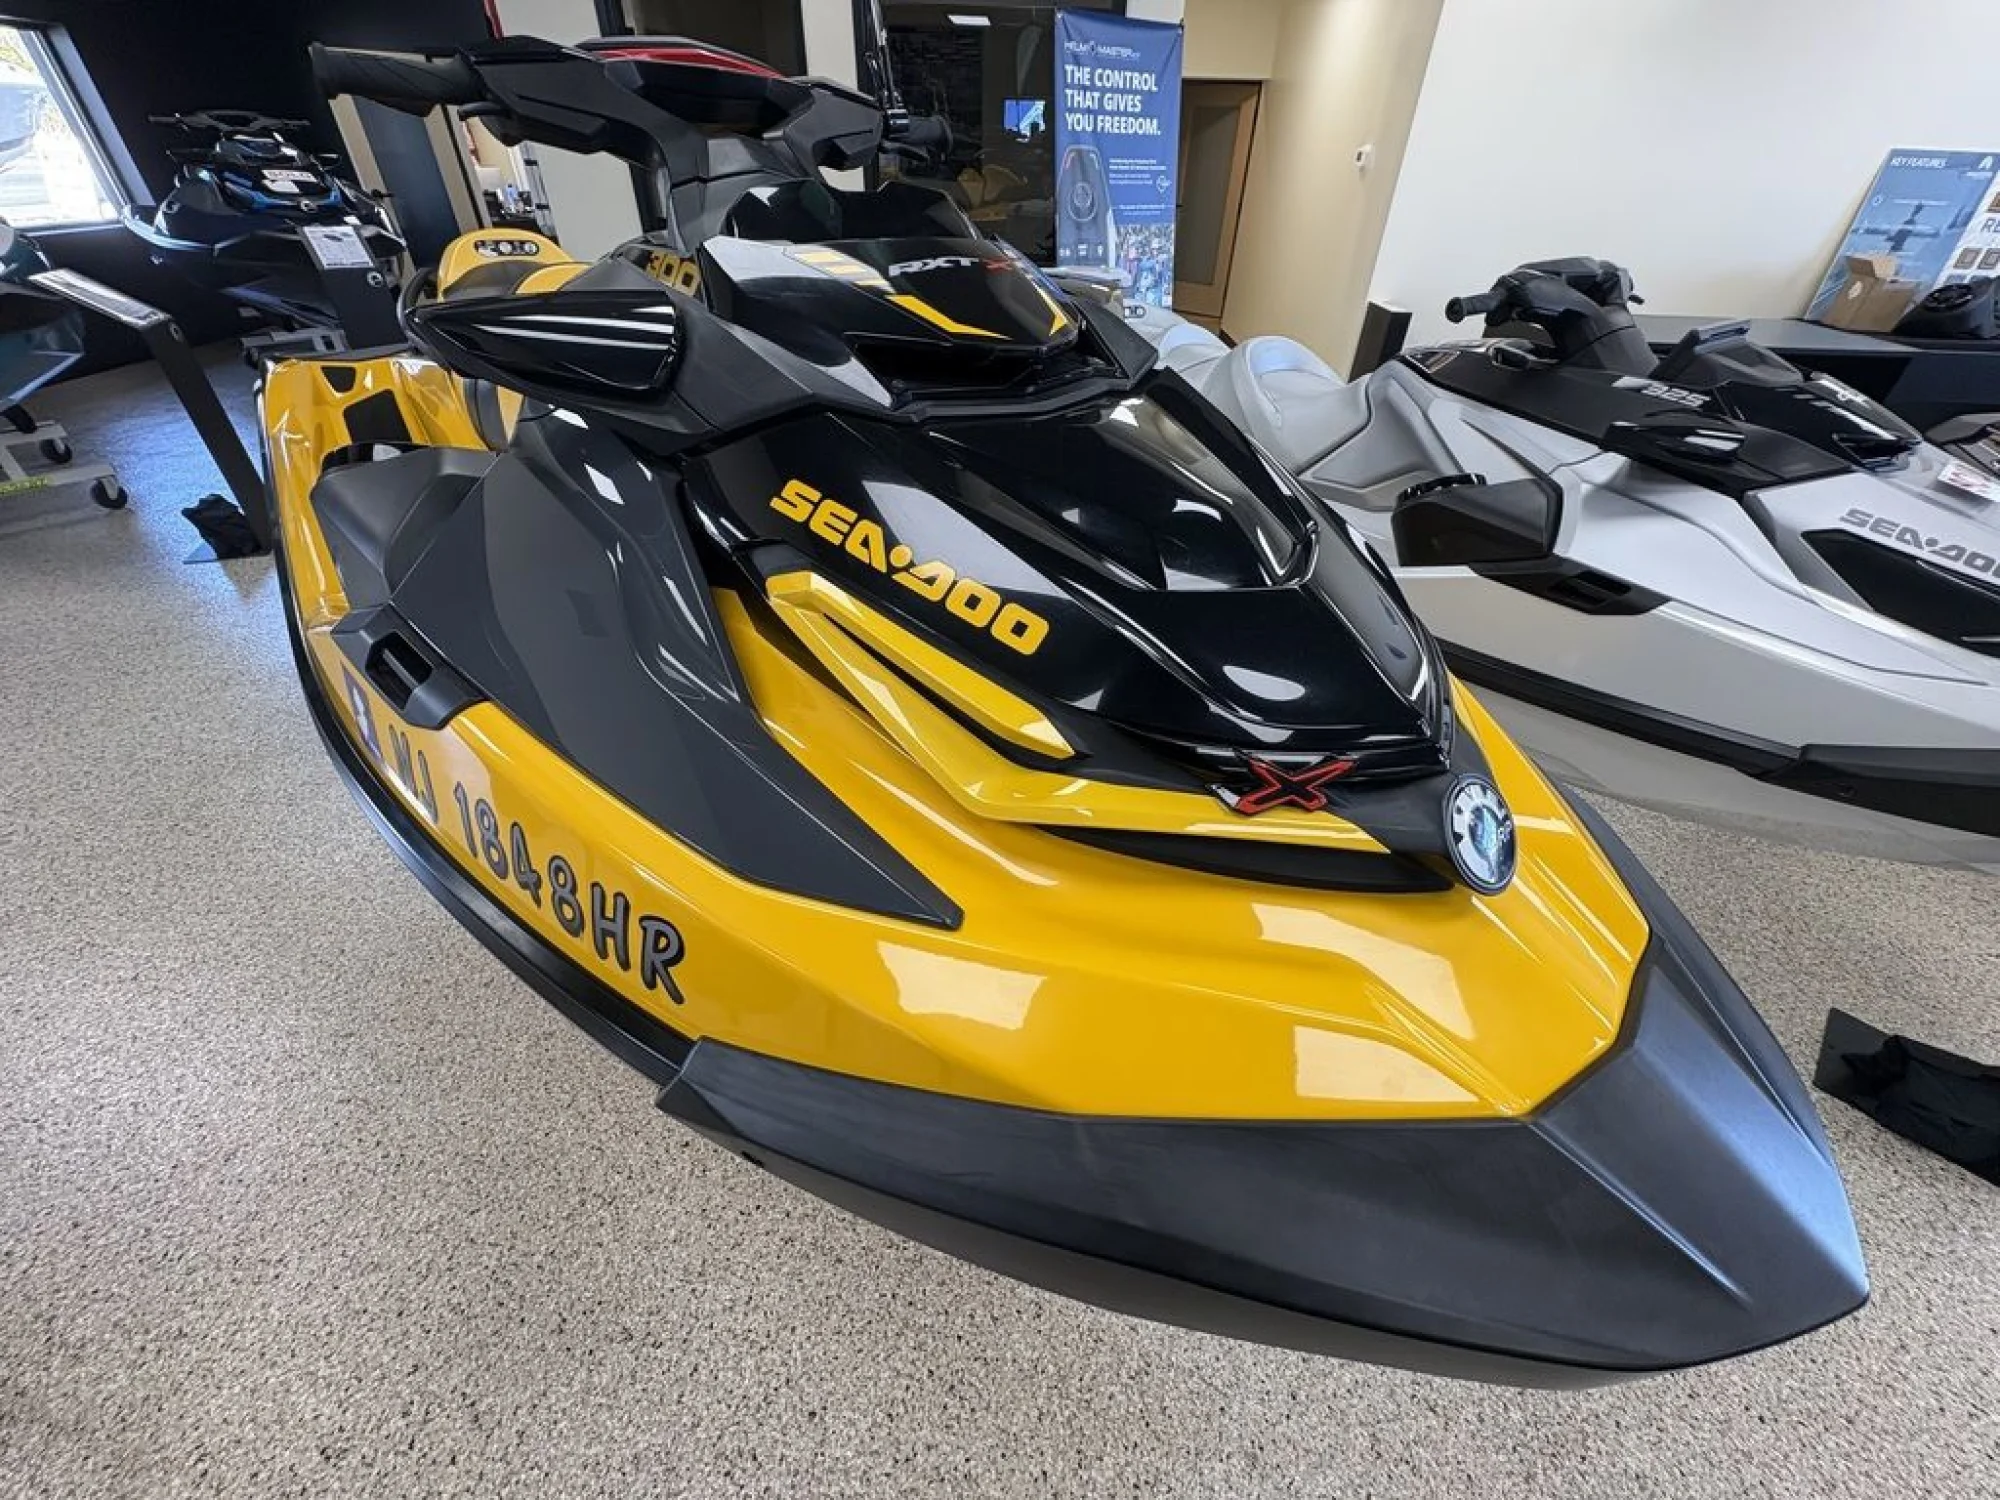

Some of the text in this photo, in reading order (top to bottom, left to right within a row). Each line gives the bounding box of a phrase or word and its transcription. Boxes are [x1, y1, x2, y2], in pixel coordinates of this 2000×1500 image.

[1064, 64, 1159, 93] THE CONTROL
[1064, 88, 1142, 112] THAT GIVES
[1064, 112, 1161, 136] YOU FREEDOM.
[888, 255, 979, 277] RXT
[453, 780, 686, 1005] 1848HR
